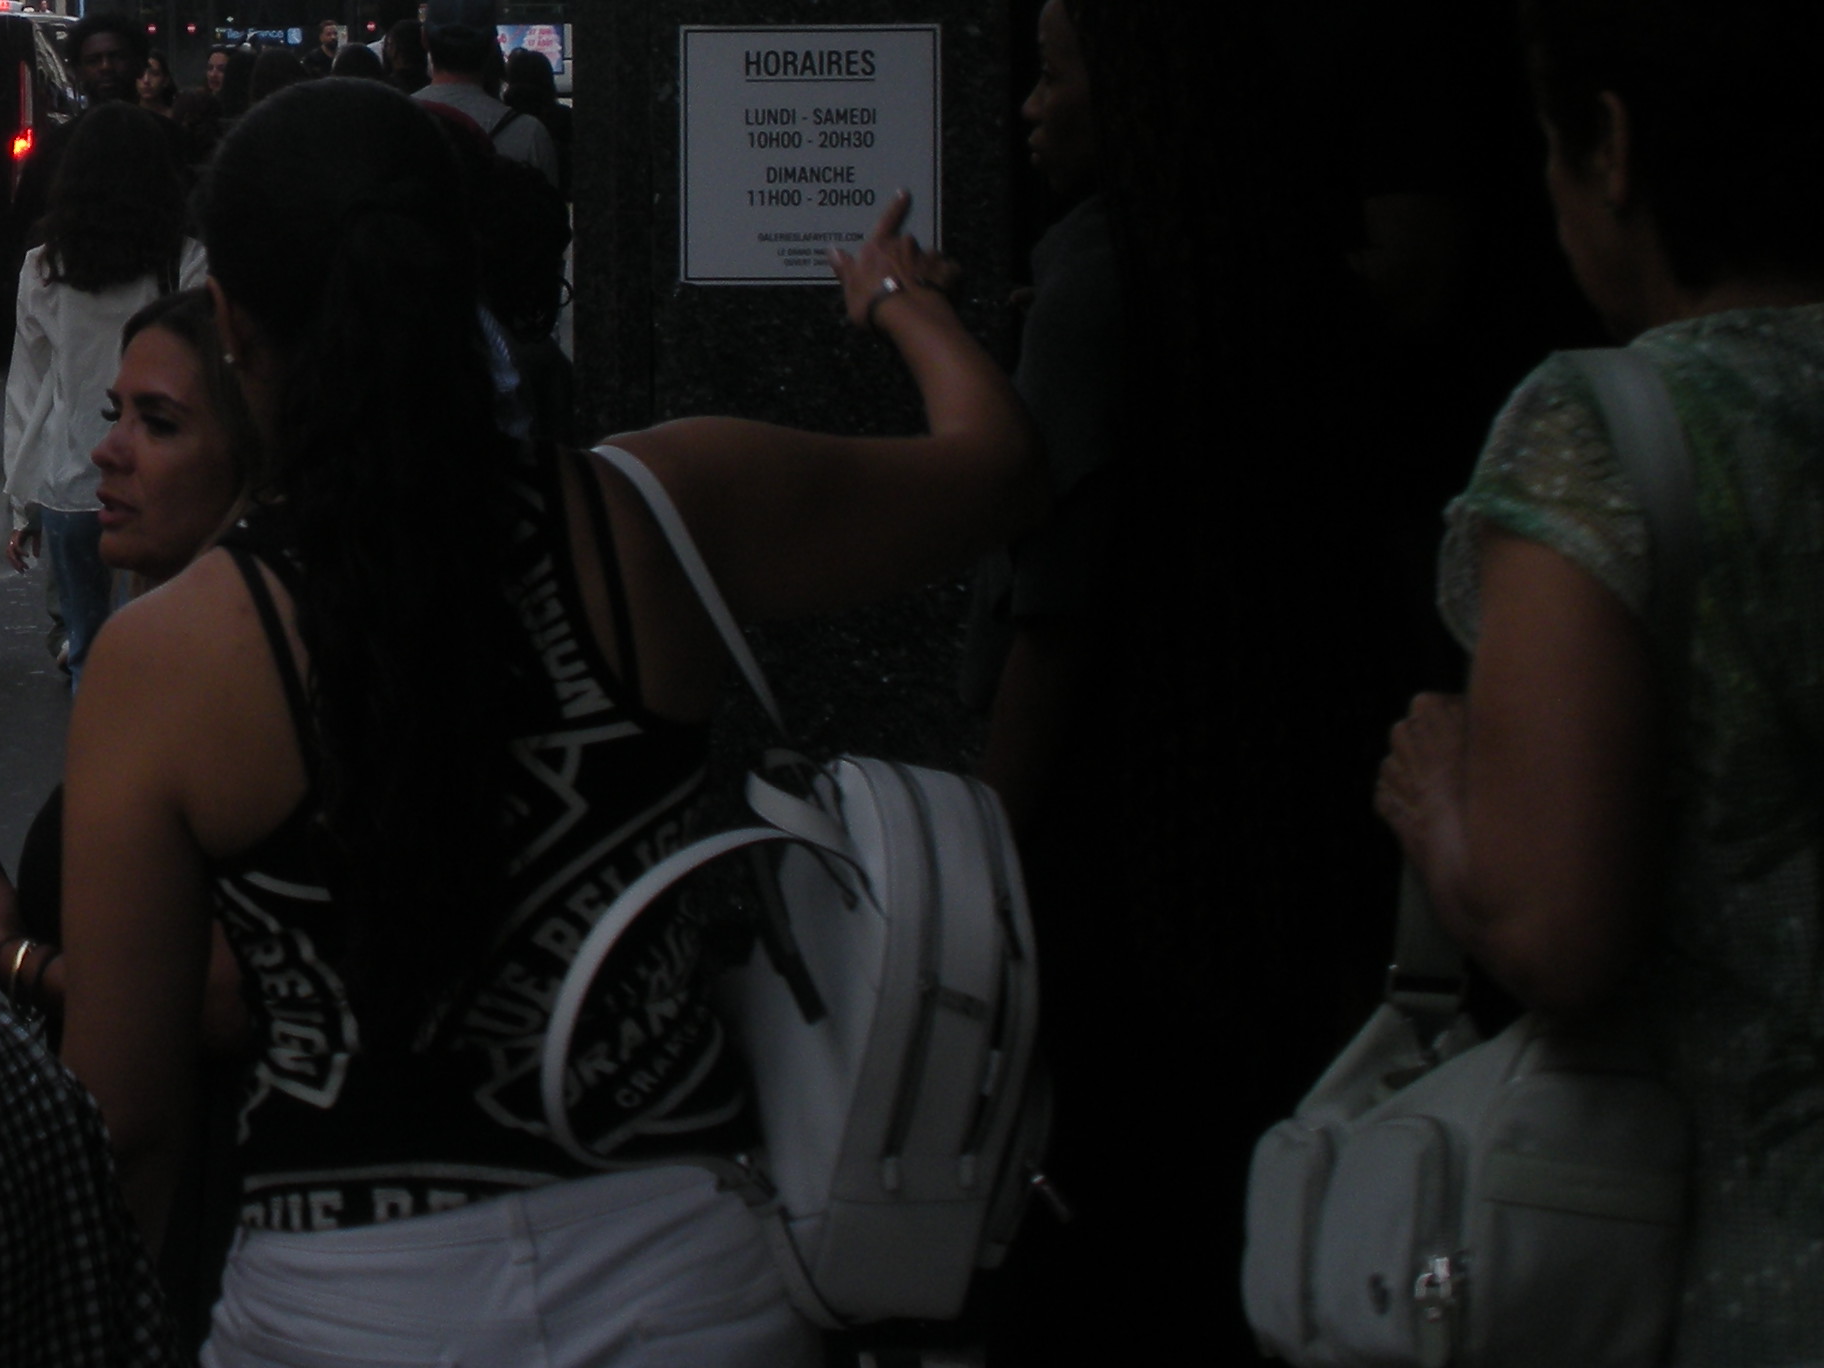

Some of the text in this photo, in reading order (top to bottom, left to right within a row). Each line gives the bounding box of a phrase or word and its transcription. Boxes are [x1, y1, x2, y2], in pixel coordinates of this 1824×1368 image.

[744, 49, 876, 76] HORAIRES
[745, 108, 796, 125] LUNDI
[812, 107, 877, 125] SAMEDI
[748, 131, 802, 148] 10H00
[818, 130, 875, 148] 20H30
[766, 166, 856, 183] DIMANCHE
[747, 189, 802, 206] 11H00
[817, 188, 875, 206] 20H00
